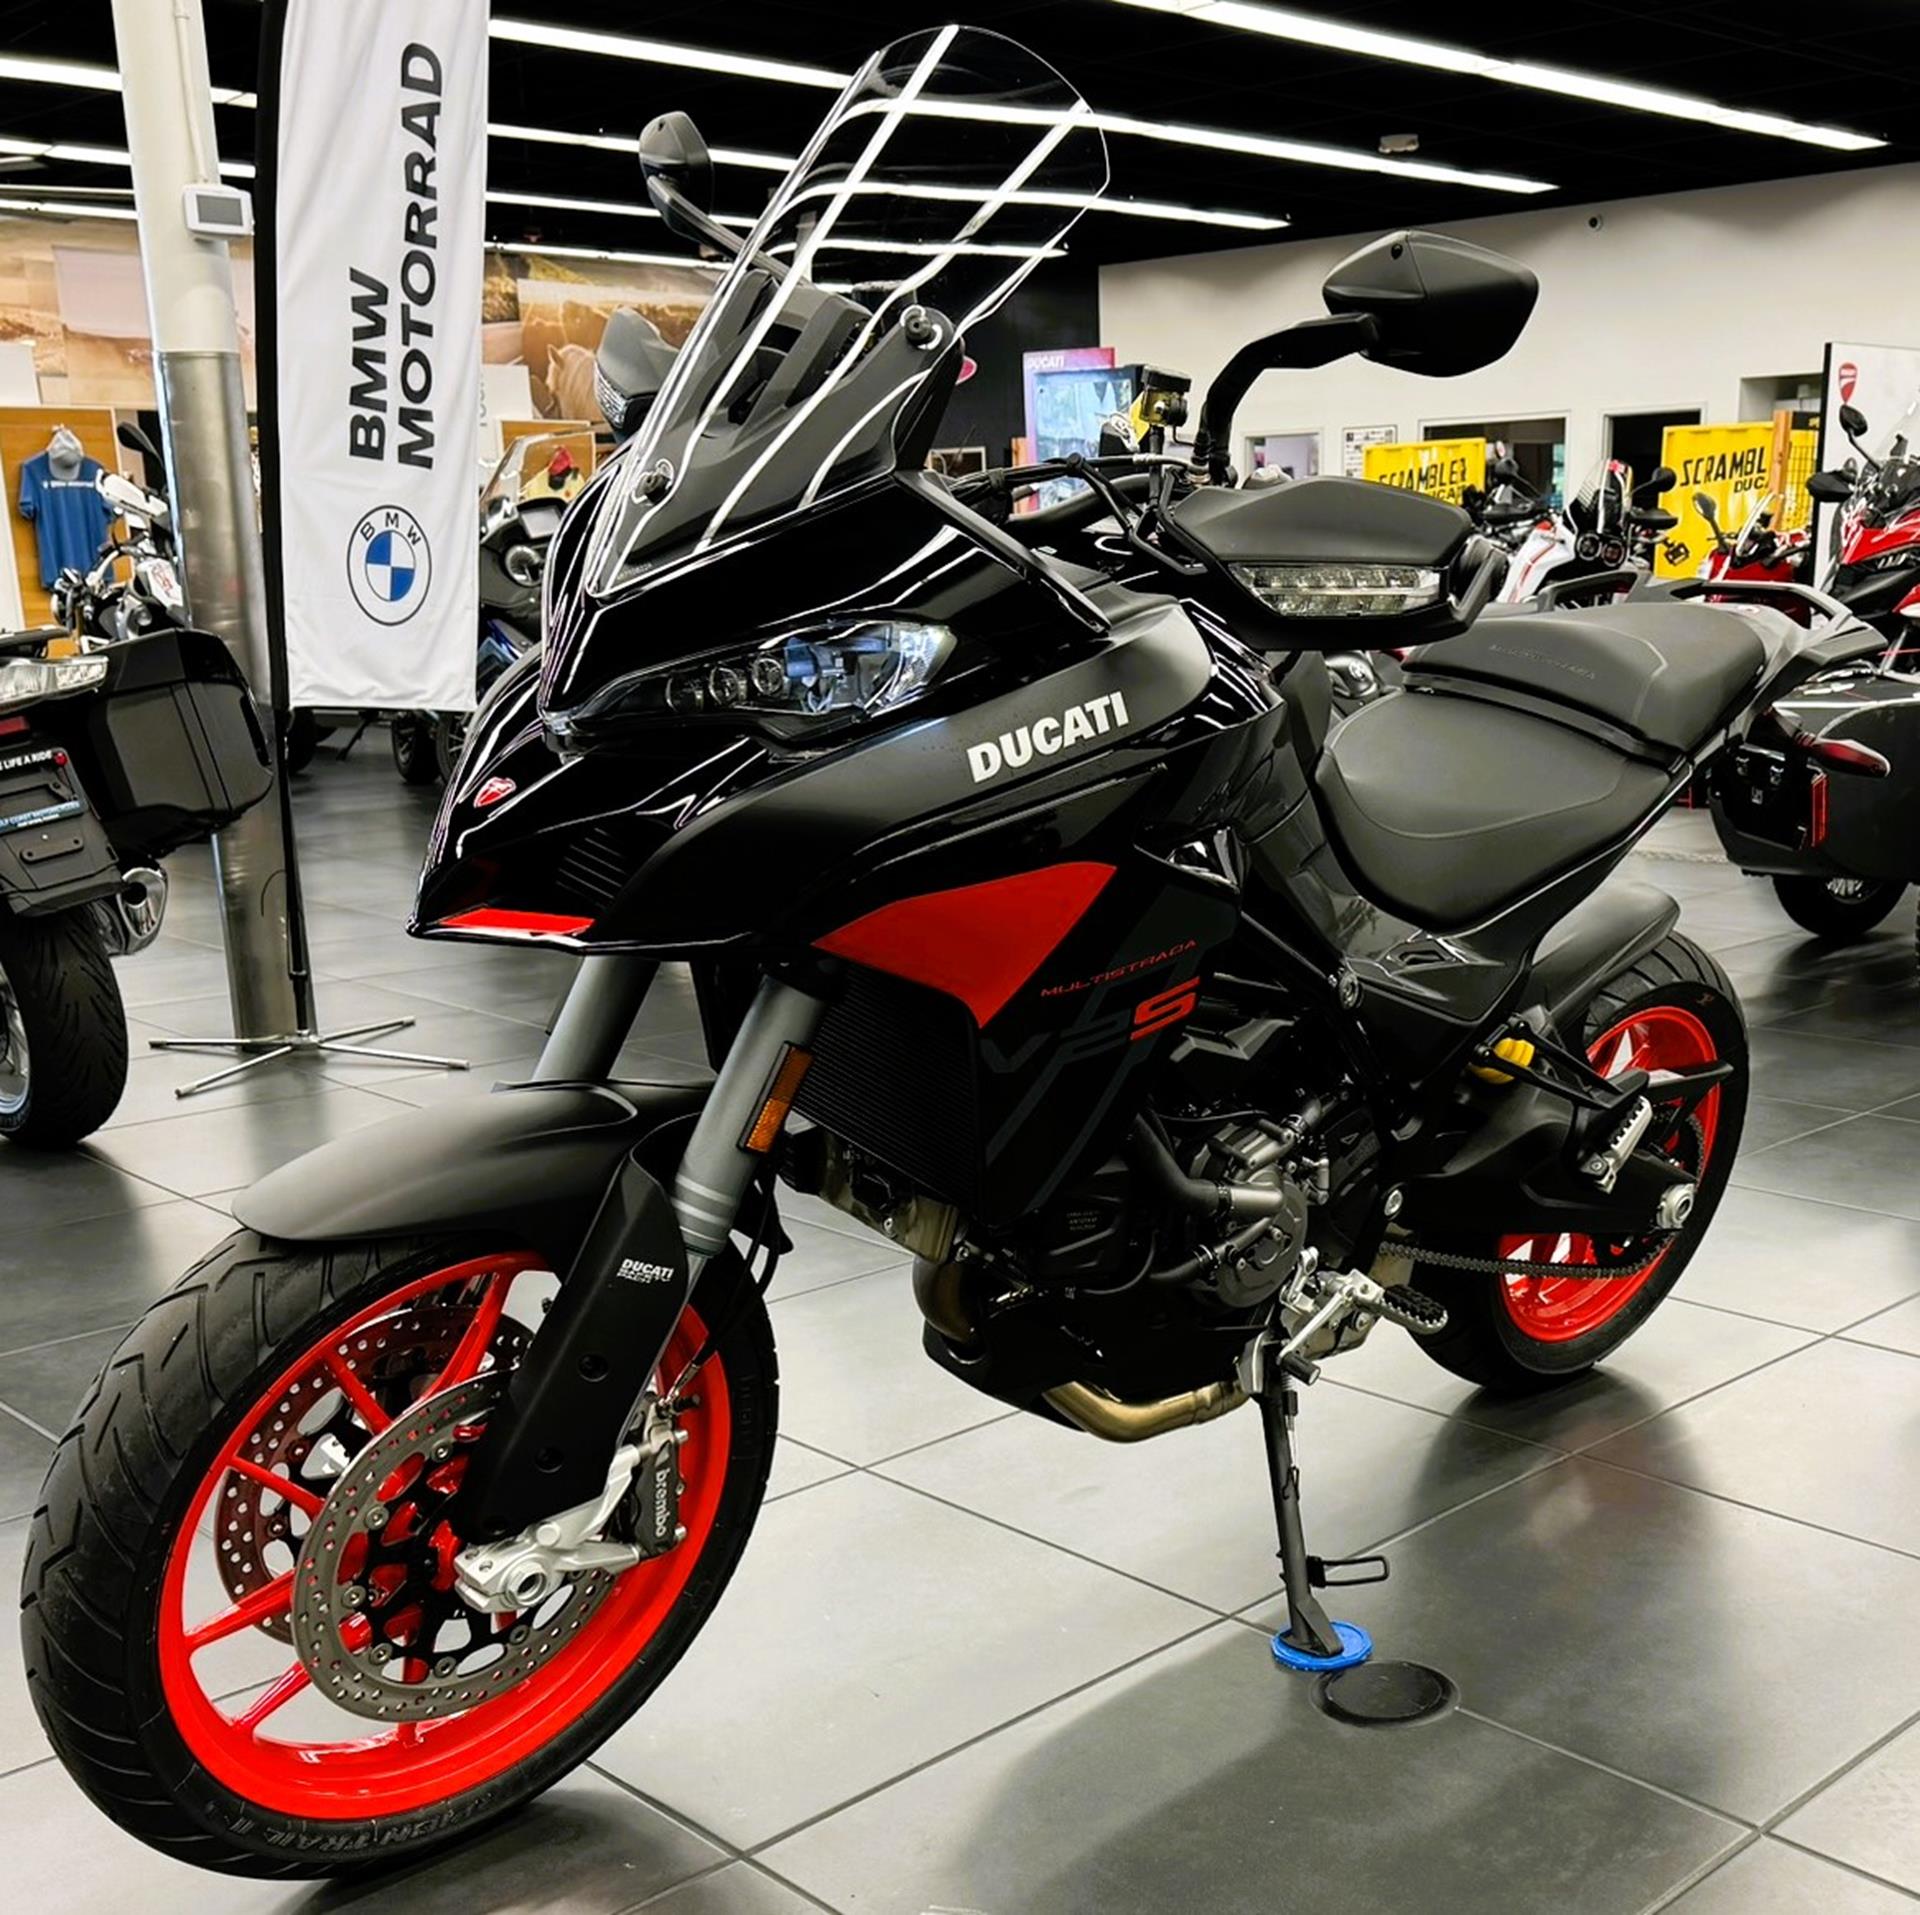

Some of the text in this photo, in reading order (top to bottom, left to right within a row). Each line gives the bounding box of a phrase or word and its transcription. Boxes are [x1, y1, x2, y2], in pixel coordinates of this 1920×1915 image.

[398, 42, 443, 469] MOTORRAD
[349, 267, 389, 461] BMW
[1027, 355, 1065, 369] DUCATI
[1680, 446, 1767, 487] SCRAMBL
[1733, 477, 1769, 494] DUC
[360, 511, 422, 546] BMW
[966, 690, 1130, 784] DUCATI
[1040, 939, 1196, 997] MULTISTRADA
[621, 1258, 674, 1279] DUCATI
[655, 1467, 671, 1537] brembo
